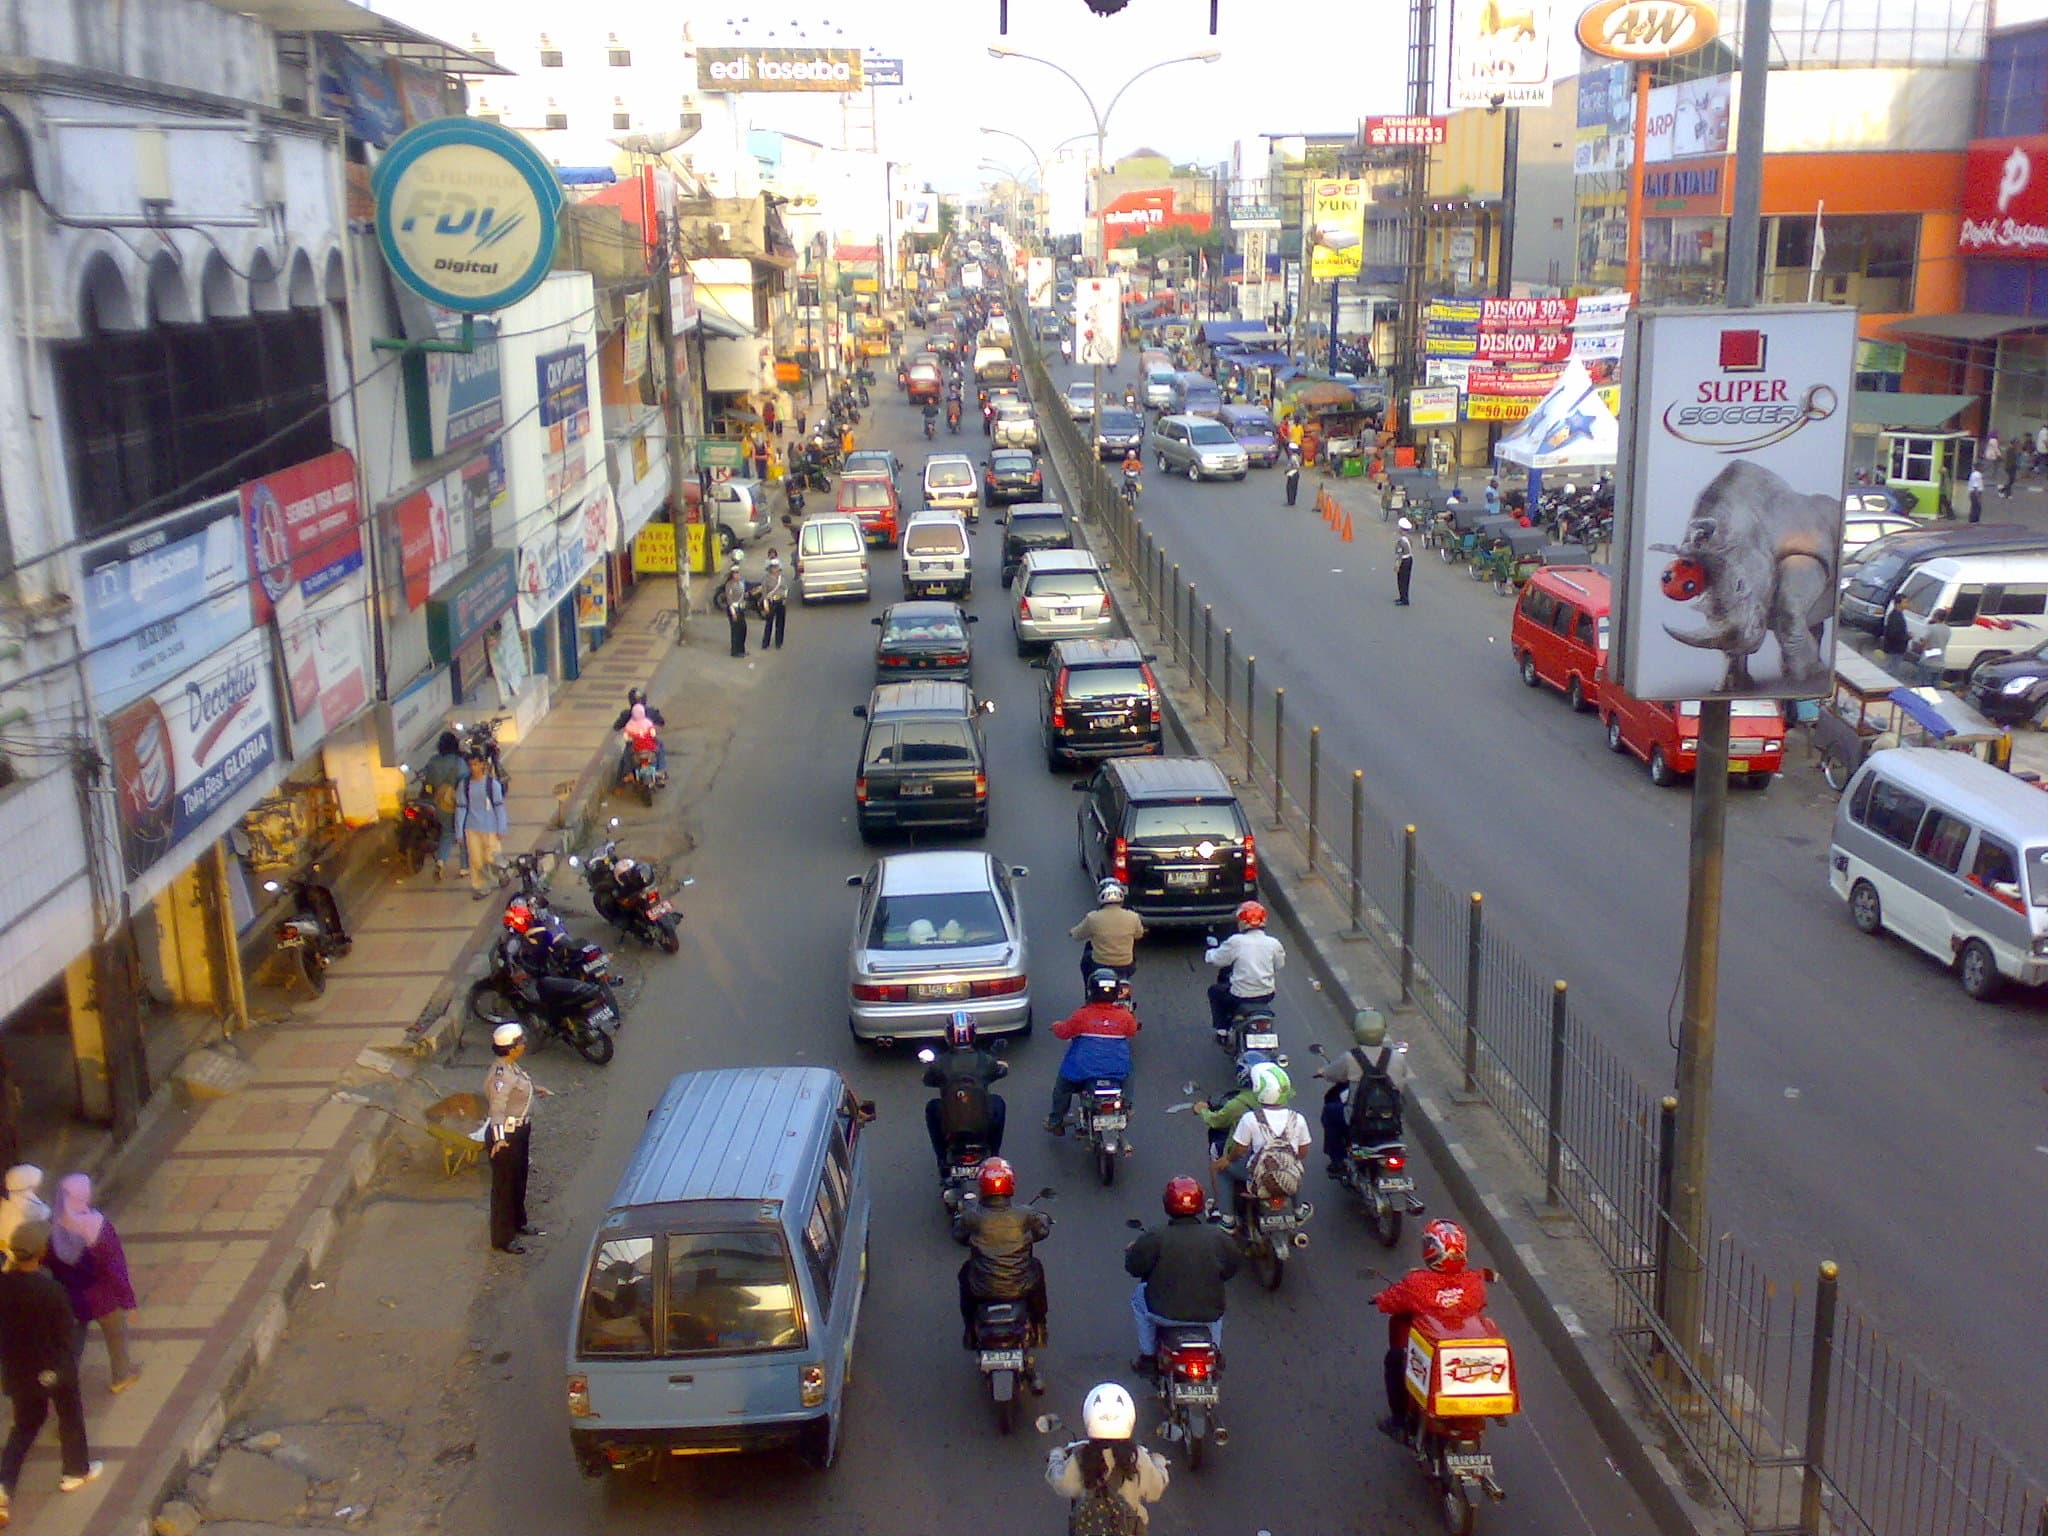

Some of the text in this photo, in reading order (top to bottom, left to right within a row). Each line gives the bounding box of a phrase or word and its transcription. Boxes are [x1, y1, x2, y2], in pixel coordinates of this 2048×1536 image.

[1603, 8, 1696, 45] A&W
[709, 57, 750, 80] edi
[756, 57, 850, 80] toserba
[1631, 114, 1673, 140] SARP
[434, 258, 499, 275] Digital
[1483, 299, 1537, 319] DISKON
[1479, 333, 1536, 353] DISKON
[1538, 333, 1569, 352] 20%
[1697, 379, 1790, 403] SUPER
[1678, 405, 1801, 426] SOCCER
[222, 733, 268, 781] GLORIA
